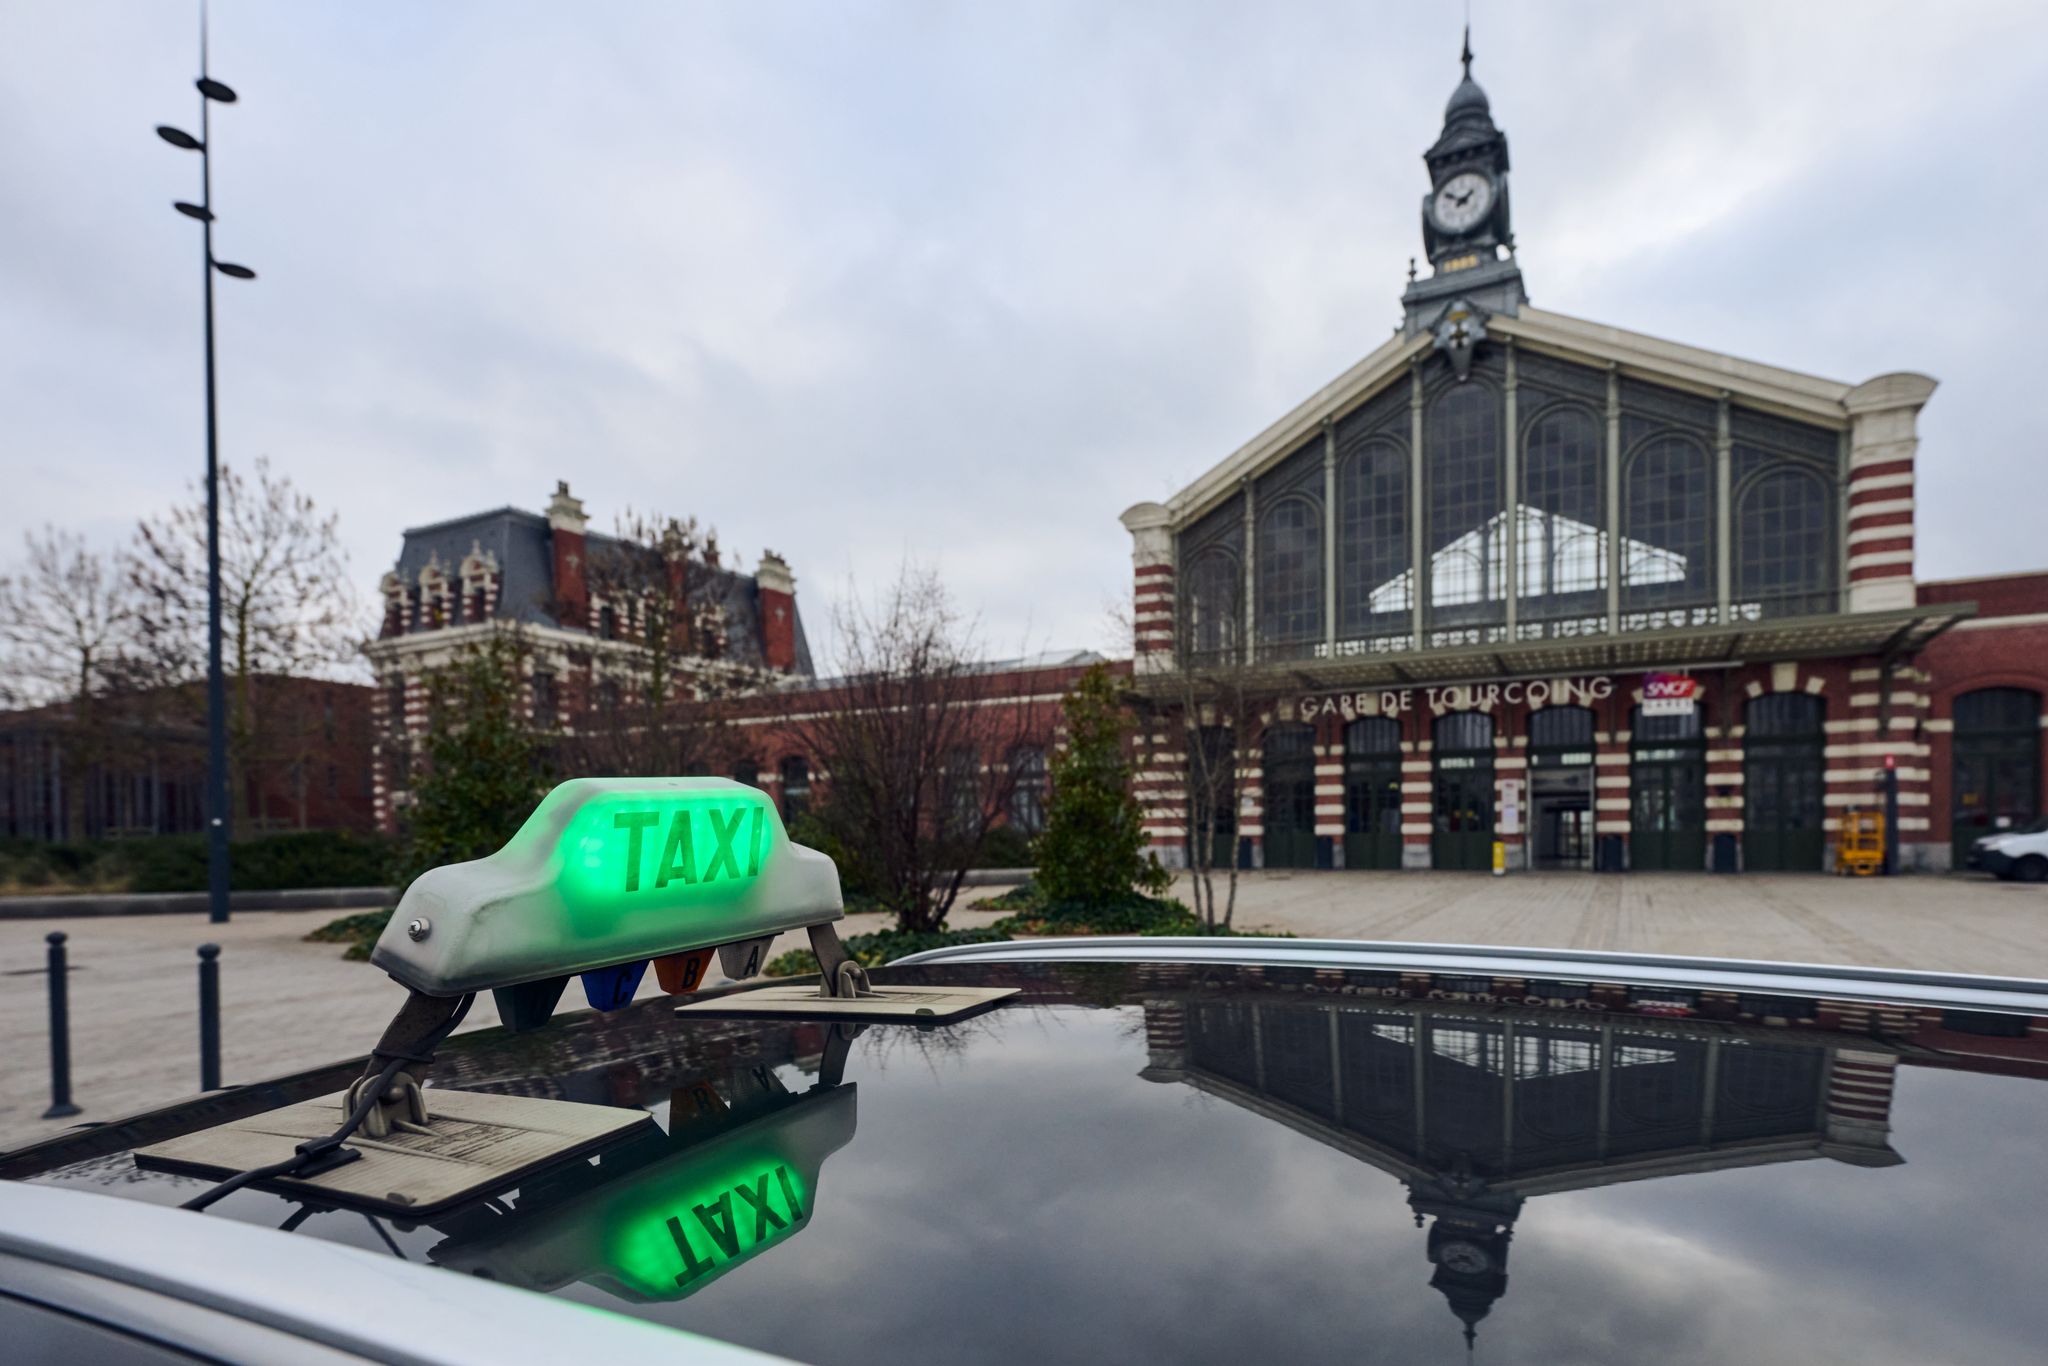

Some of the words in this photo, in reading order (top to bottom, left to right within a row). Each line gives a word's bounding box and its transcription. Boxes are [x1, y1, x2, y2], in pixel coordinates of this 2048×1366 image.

[1301, 693, 1367, 715] GARE
[1381, 690, 1412, 712] DE
[1427, 677, 1612, 709] TOURCOING
[1647, 680, 1691, 697] SNCF
[614, 807, 764, 892] TAXI
[682, 957, 700, 989] B
[744, 946, 759, 976] A
[613, 969, 632, 1005] C
